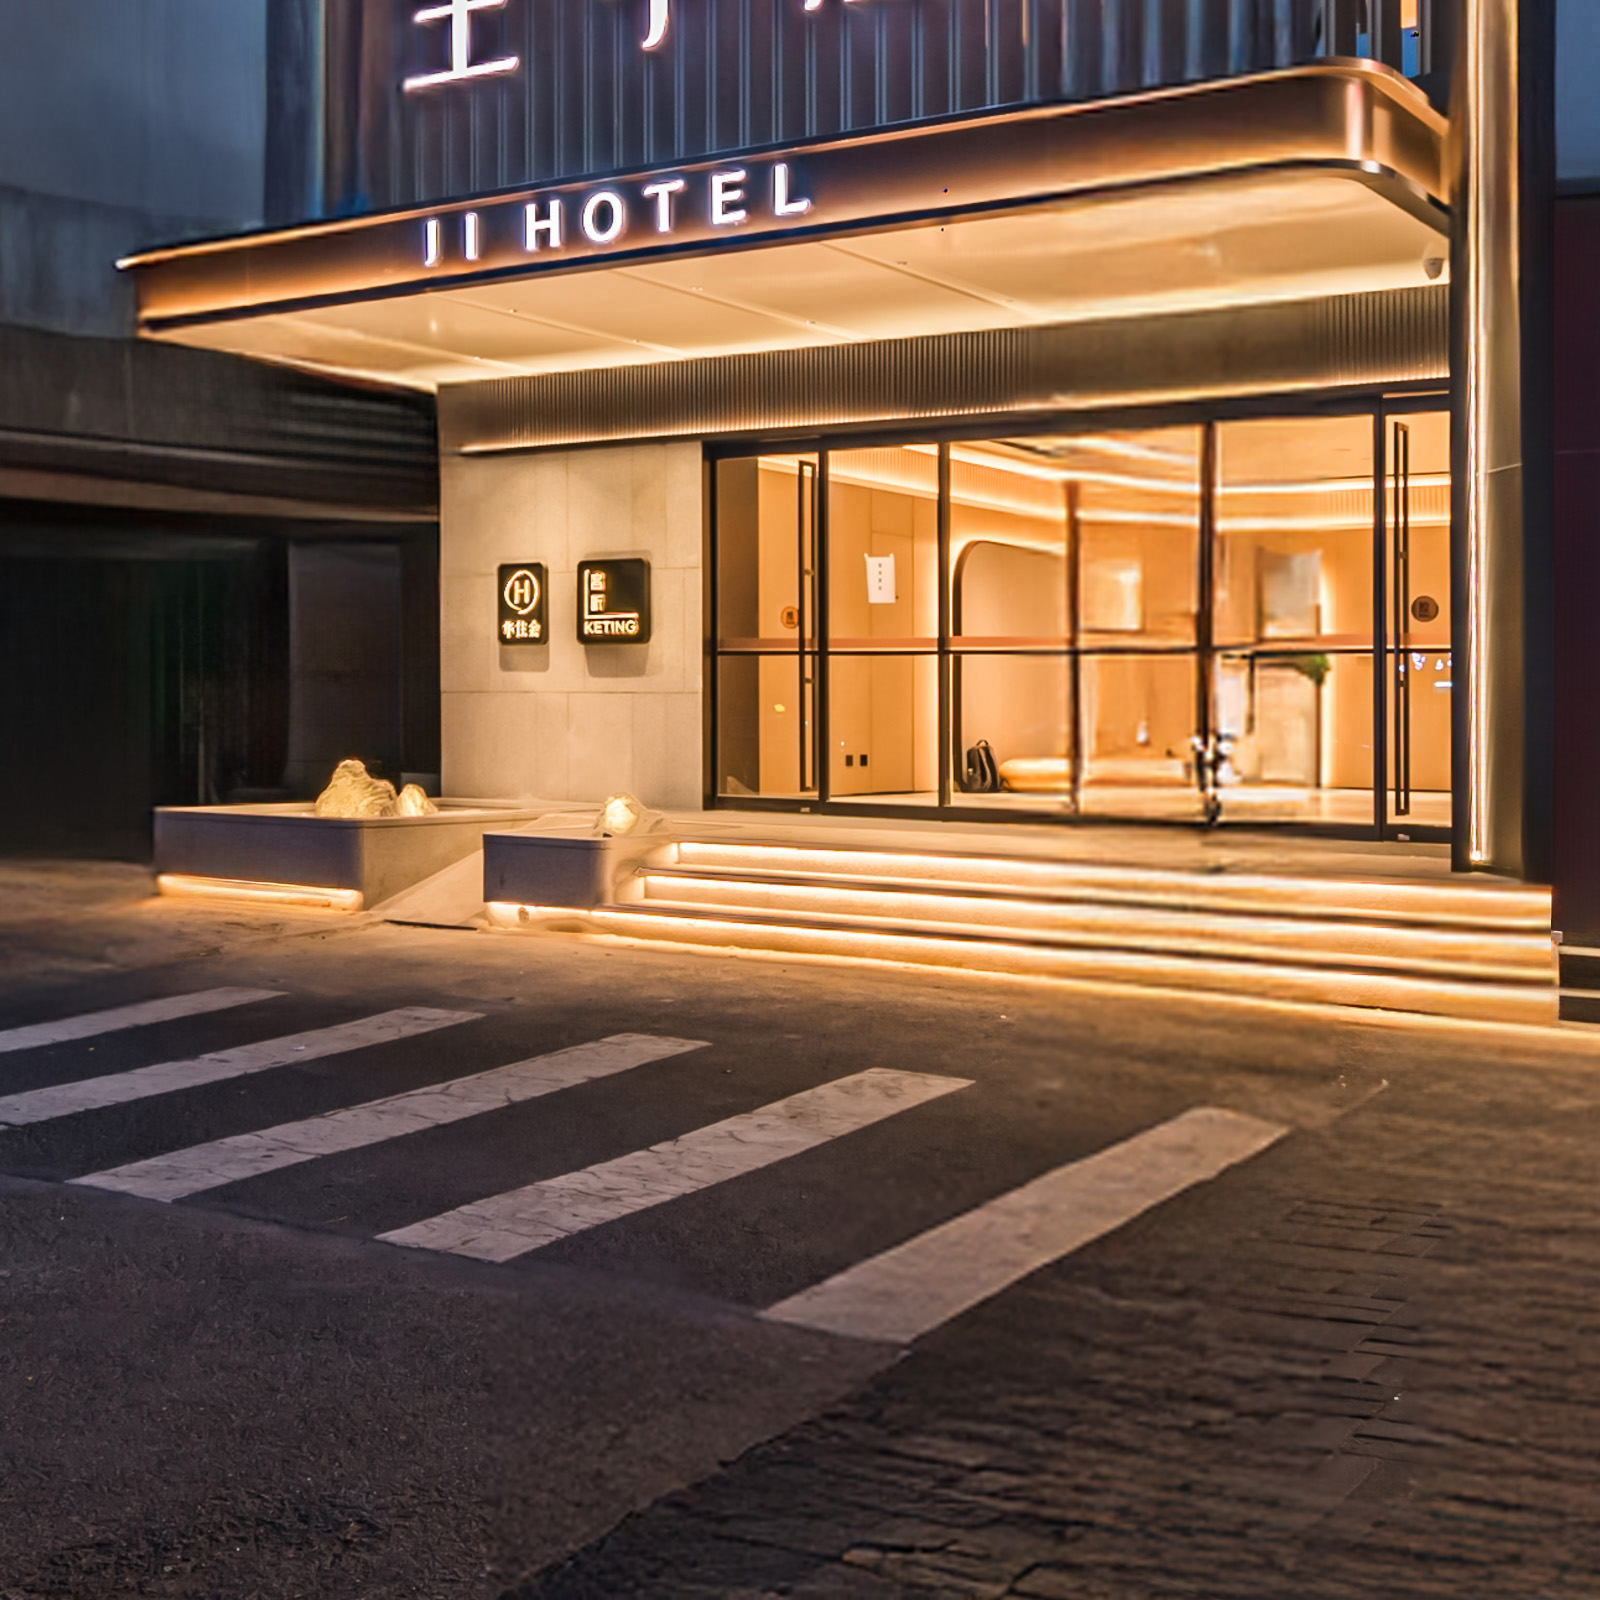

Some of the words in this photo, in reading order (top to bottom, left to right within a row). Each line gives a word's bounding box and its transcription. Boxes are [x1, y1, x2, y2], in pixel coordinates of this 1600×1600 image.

[423, 211, 479, 268] JI
[525, 163, 811, 252] HOTEL
[584, 620, 639, 635] KETING
